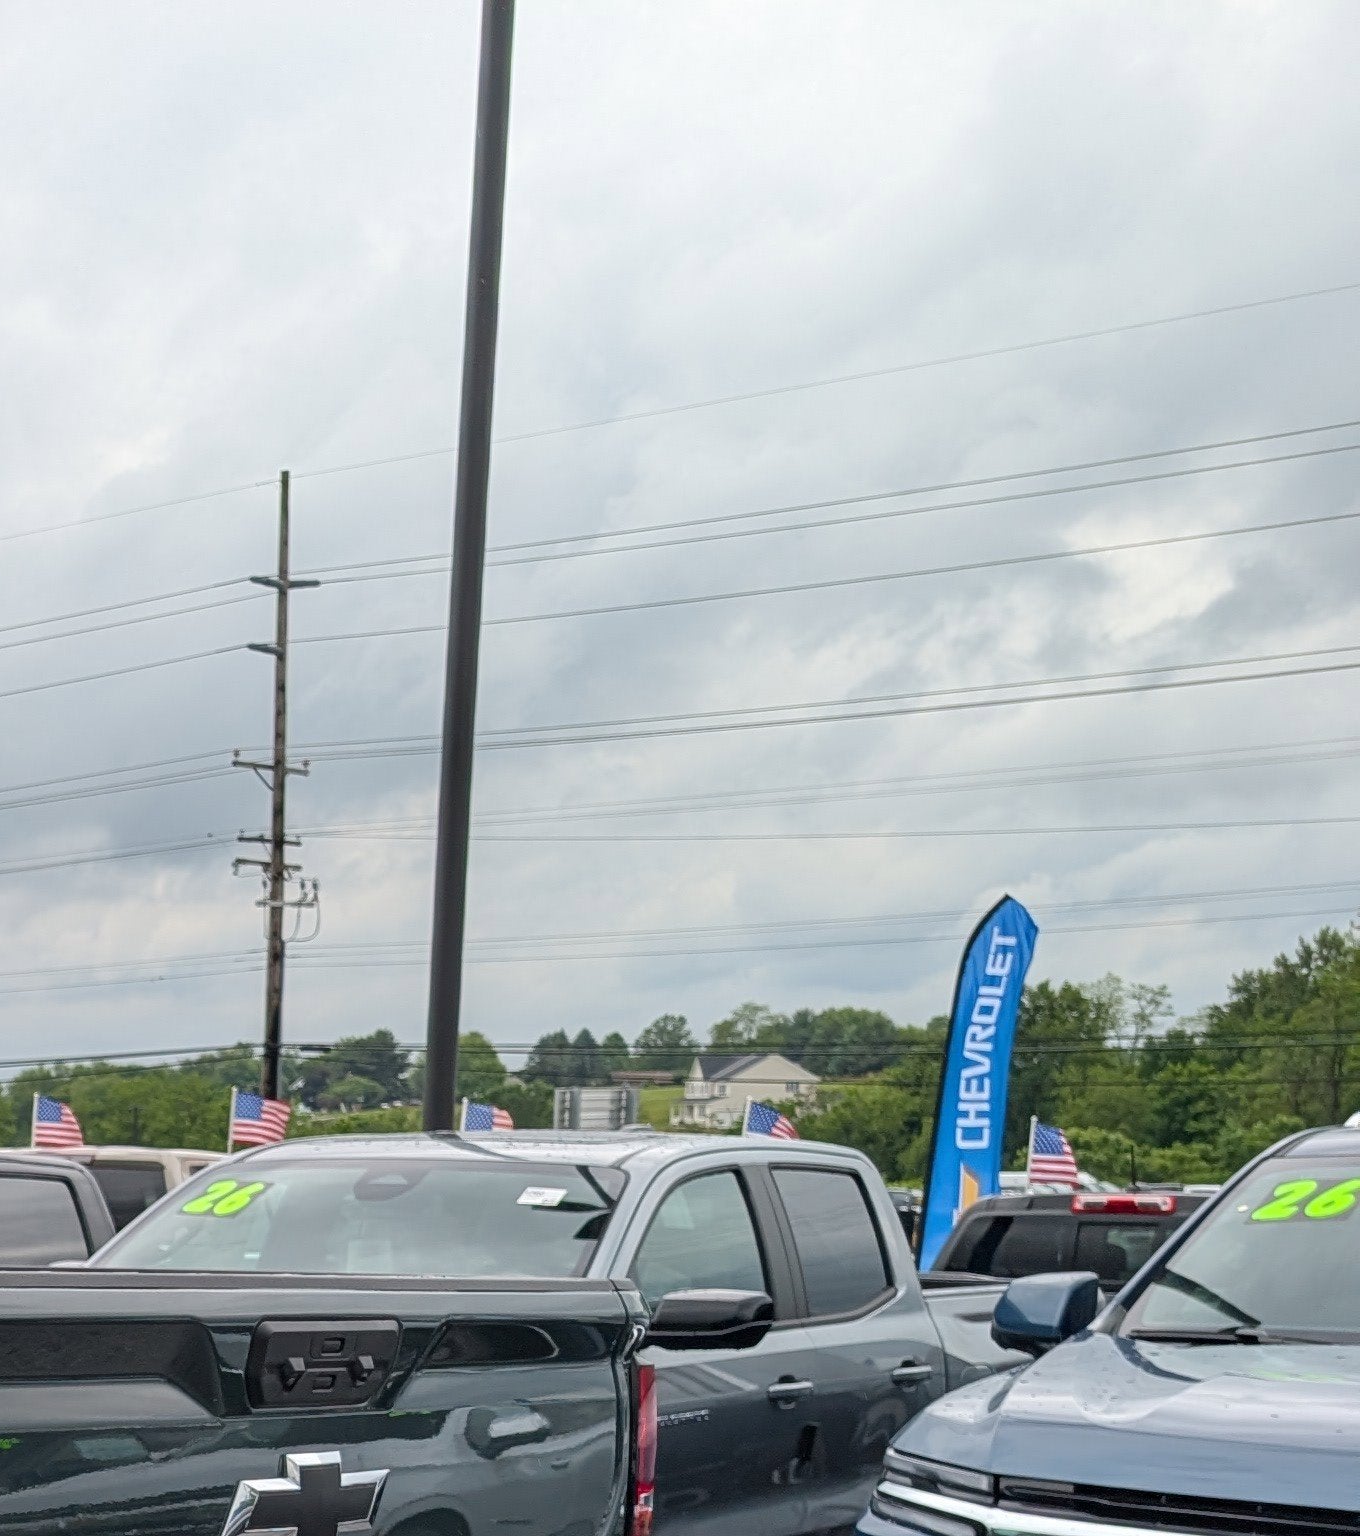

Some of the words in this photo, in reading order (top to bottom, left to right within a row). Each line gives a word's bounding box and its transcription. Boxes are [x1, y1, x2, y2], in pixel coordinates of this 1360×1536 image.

[955, 926, 1018, 1150] CHEVROLET
[181, 1179, 266, 1217] 26
[1251, 1178, 1360, 1221] 26
